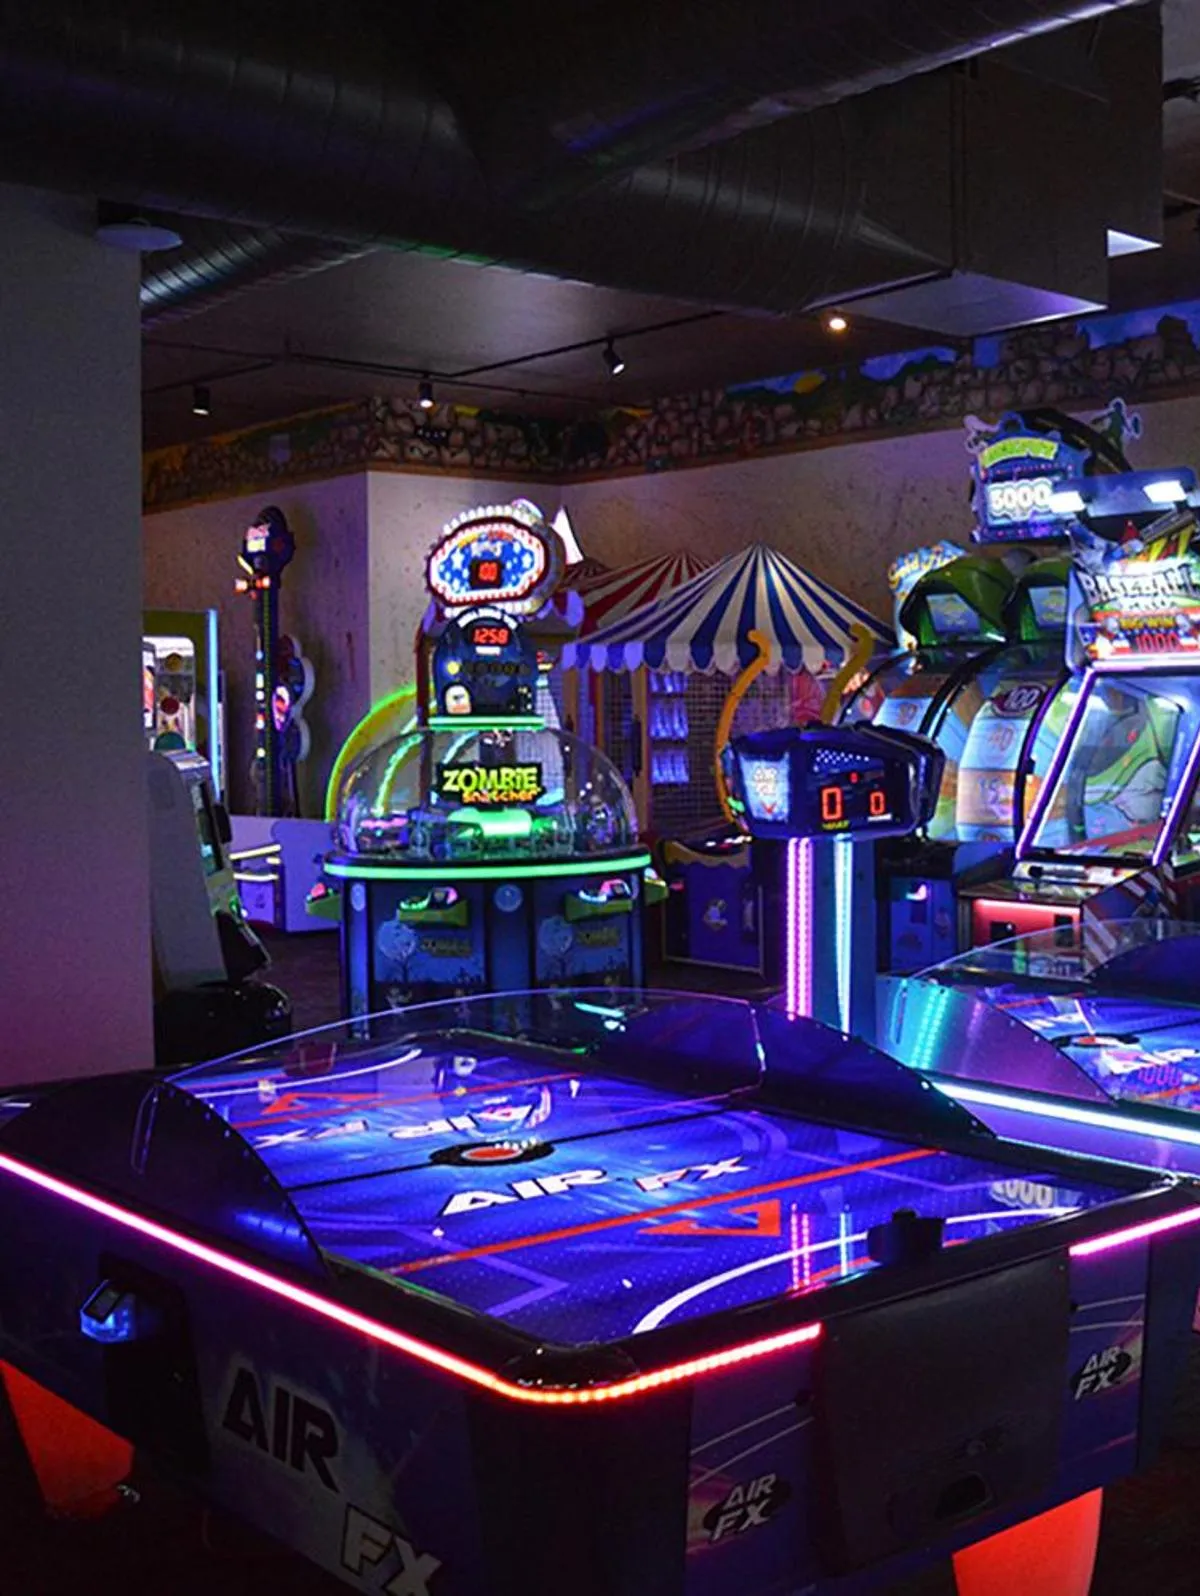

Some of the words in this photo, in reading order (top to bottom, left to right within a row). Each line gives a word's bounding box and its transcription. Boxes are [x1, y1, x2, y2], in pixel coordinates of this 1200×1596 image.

[822, 787, 842, 820] 0
[439, 1168, 611, 1217] AIR
[634, 1155, 750, 1193] FX
[1081, 1345, 1120, 1375] AIR
[1074, 1366, 1116, 1401] FX
[222, 1366, 341, 1493] AIR
[723, 1472, 777, 1511] AIR
[712, 1498, 770, 1541] FX
[340, 1502, 443, 1596] FX
